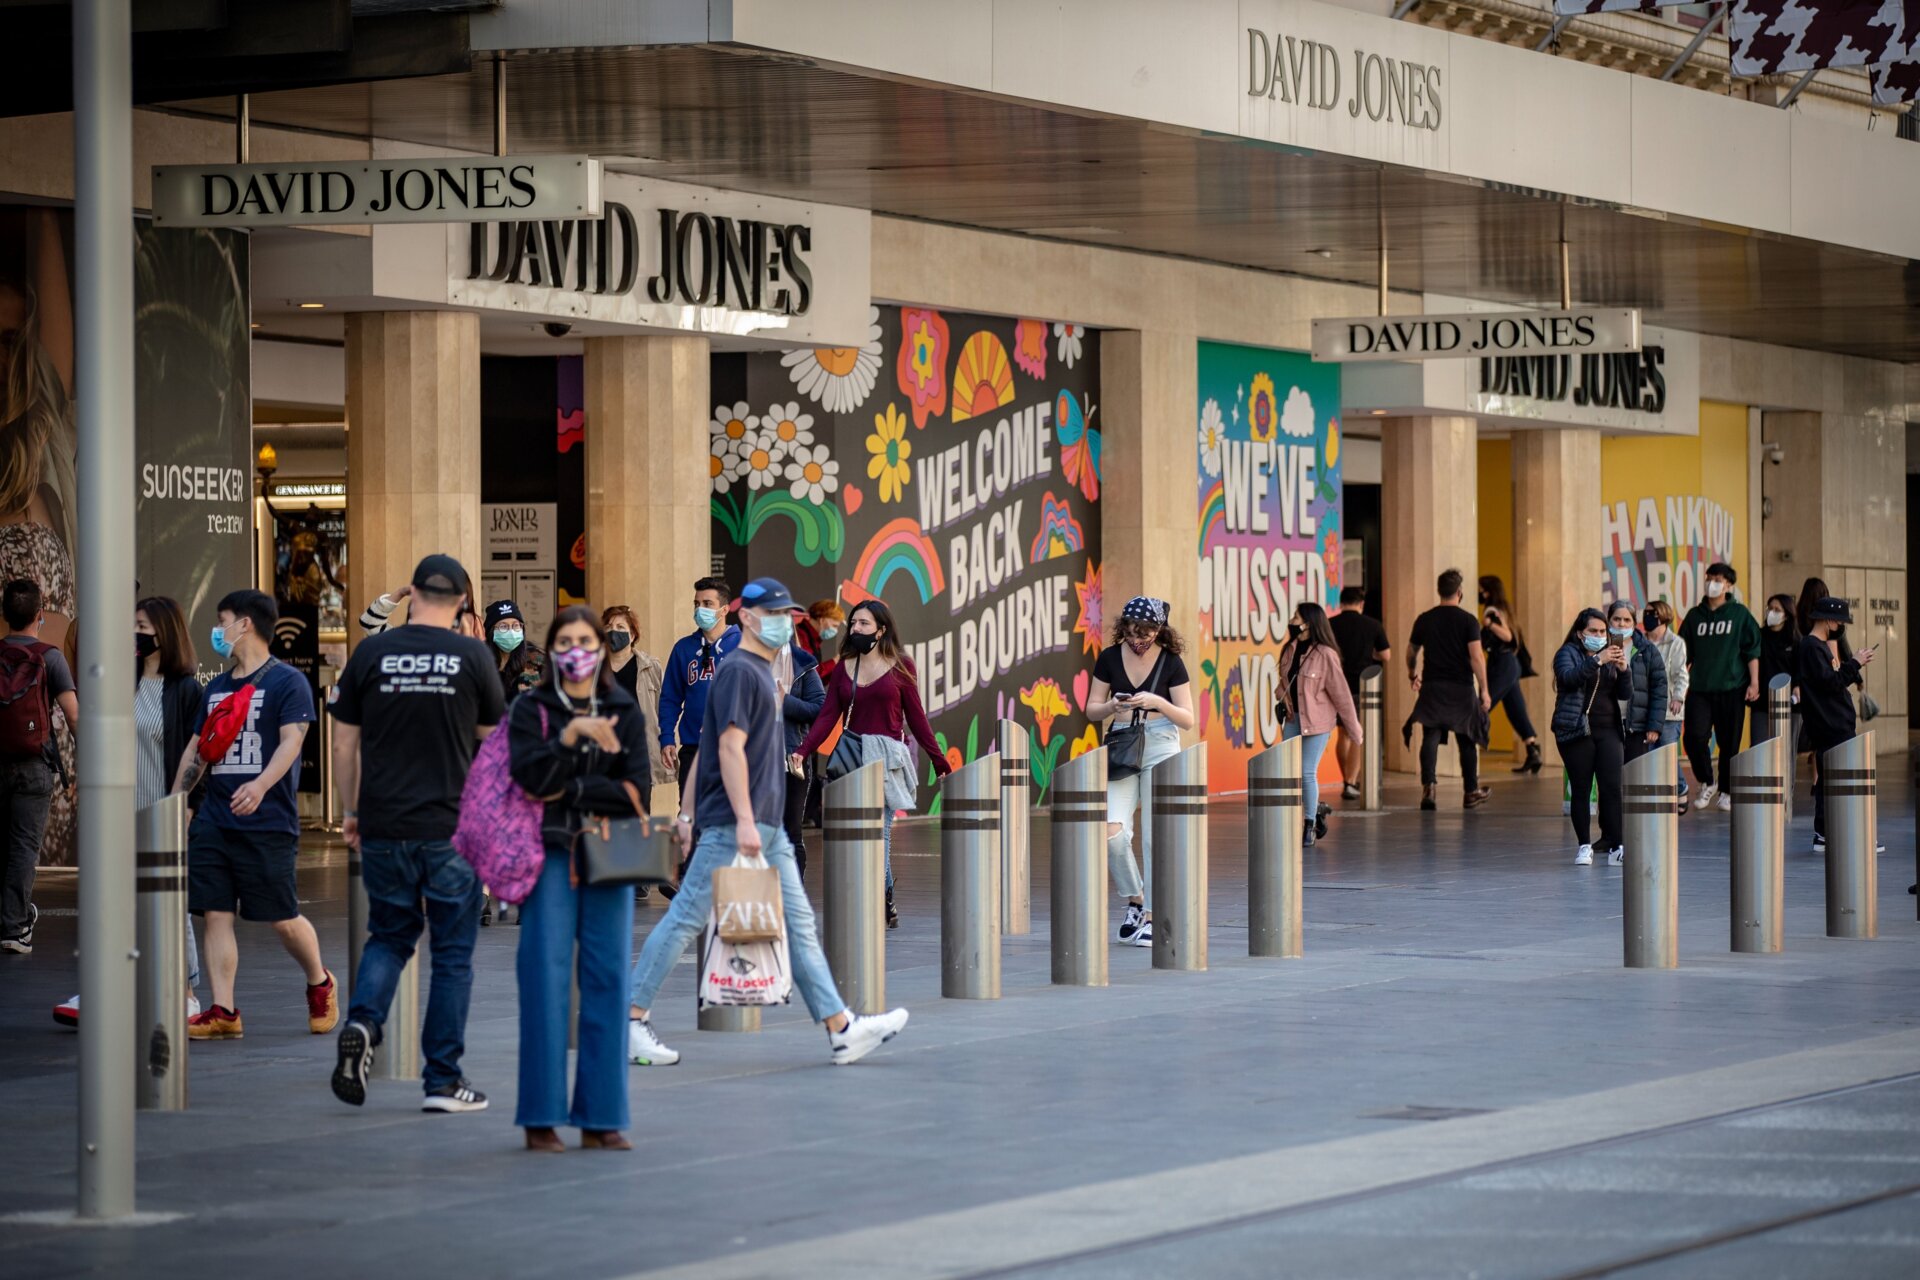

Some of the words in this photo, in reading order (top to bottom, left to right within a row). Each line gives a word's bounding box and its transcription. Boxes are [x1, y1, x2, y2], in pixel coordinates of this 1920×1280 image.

[1247, 27, 1342, 111] DAVID
[1348, 50, 1442, 132] JONES
[201, 171, 355, 216] DAVID
[370, 165, 537, 213] JONES
[466, 201, 640, 296] DAVID
[647, 208, 813, 317] JONES
[1347, 322, 1461, 354] DAVID
[1472, 315, 1595, 350] JONES
[1479, 354, 1571, 401] DAVID
[1573, 345, 1667, 414] JONES
[917, 401, 1052, 534] WELCOME
[1221, 438, 1317, 537] WE'VE
[207, 513, 243, 534] re:new
[950, 500, 1024, 615] BACK
[1602, 496, 1704, 559] HANK
[1213, 546, 1327, 643] MISSED
[381, 654, 431, 673] EOS
[433, 653, 461, 674] R5
[687, 656, 717, 686] GA
[904, 575, 1069, 719] MELBOURNE
[1238, 653, 1281, 747] YO
[718, 902, 777, 931] ZARA
[709, 972, 733, 986] Foot
